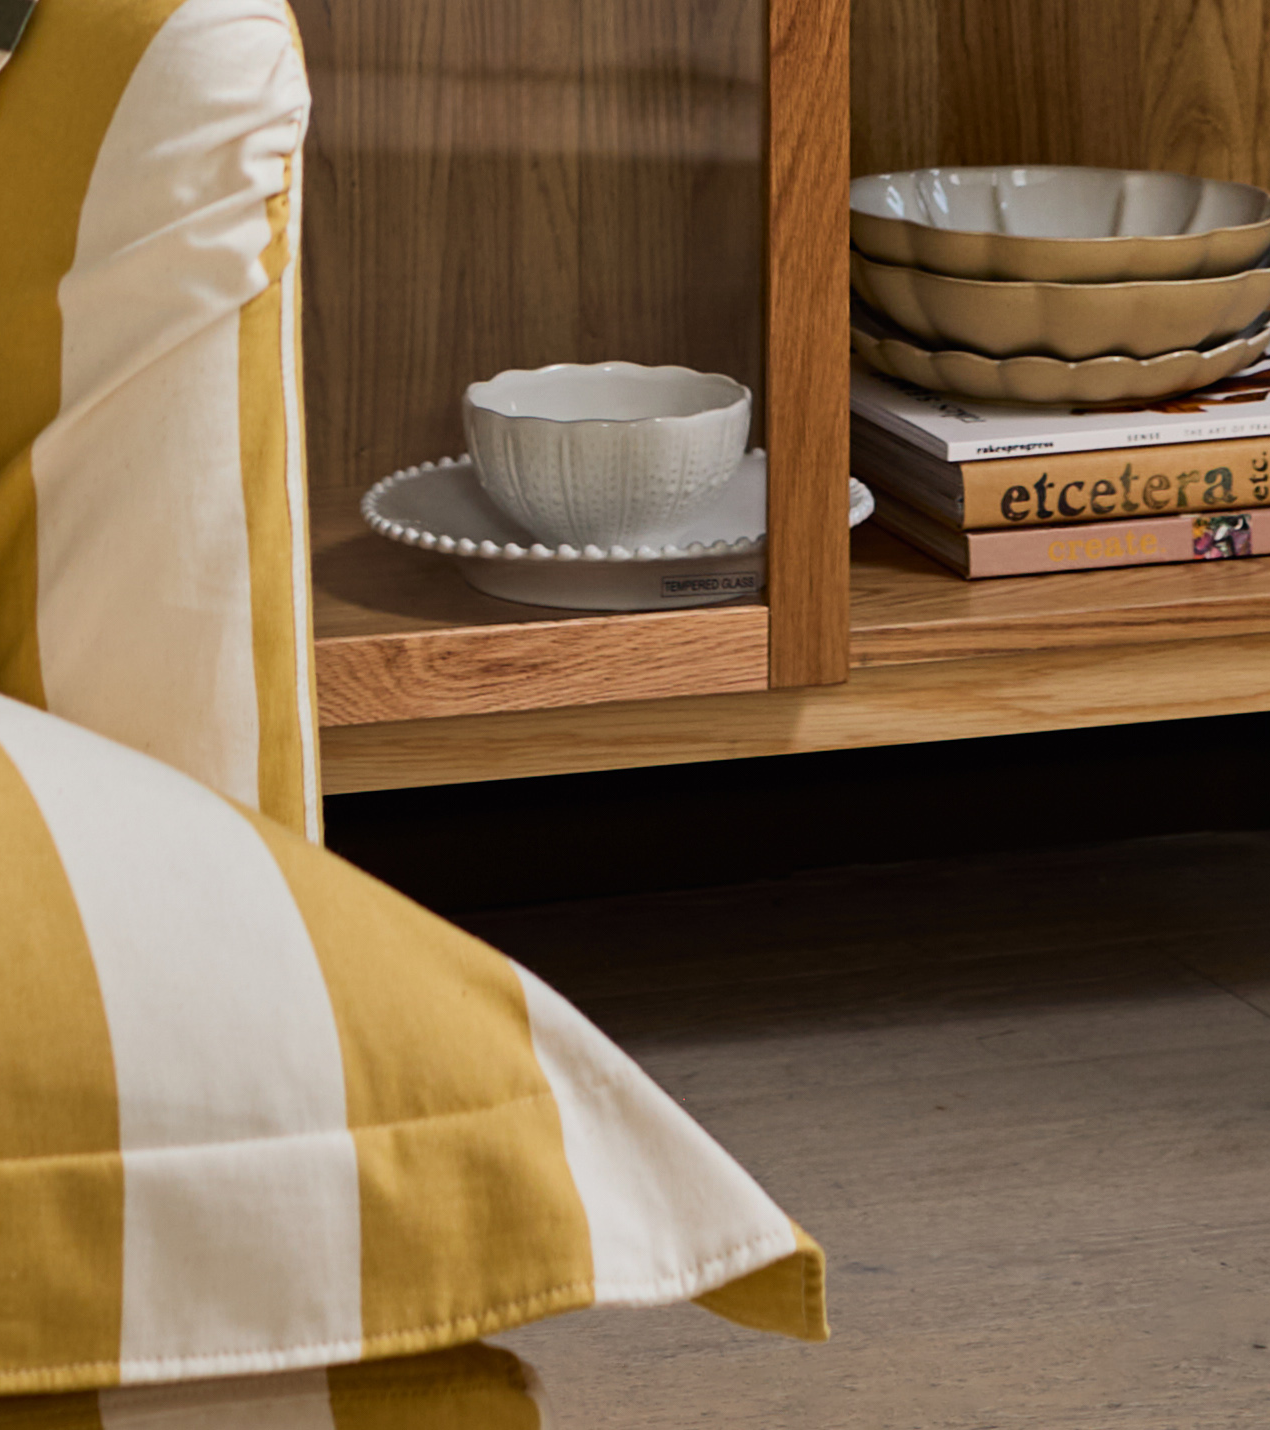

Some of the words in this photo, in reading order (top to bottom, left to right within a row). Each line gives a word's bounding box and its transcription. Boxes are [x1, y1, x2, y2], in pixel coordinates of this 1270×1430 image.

[1183, 427, 1203, 437] THE
[1208, 425, 1227, 435] ART
[1231, 423, 1245, 433] OF
[1000, 462, 1239, 522] etcetera
[1247, 451, 1269, 501] etc.
[664, 578, 719, 592] TEMPERED
[721, 576, 754, 590] GLASS
